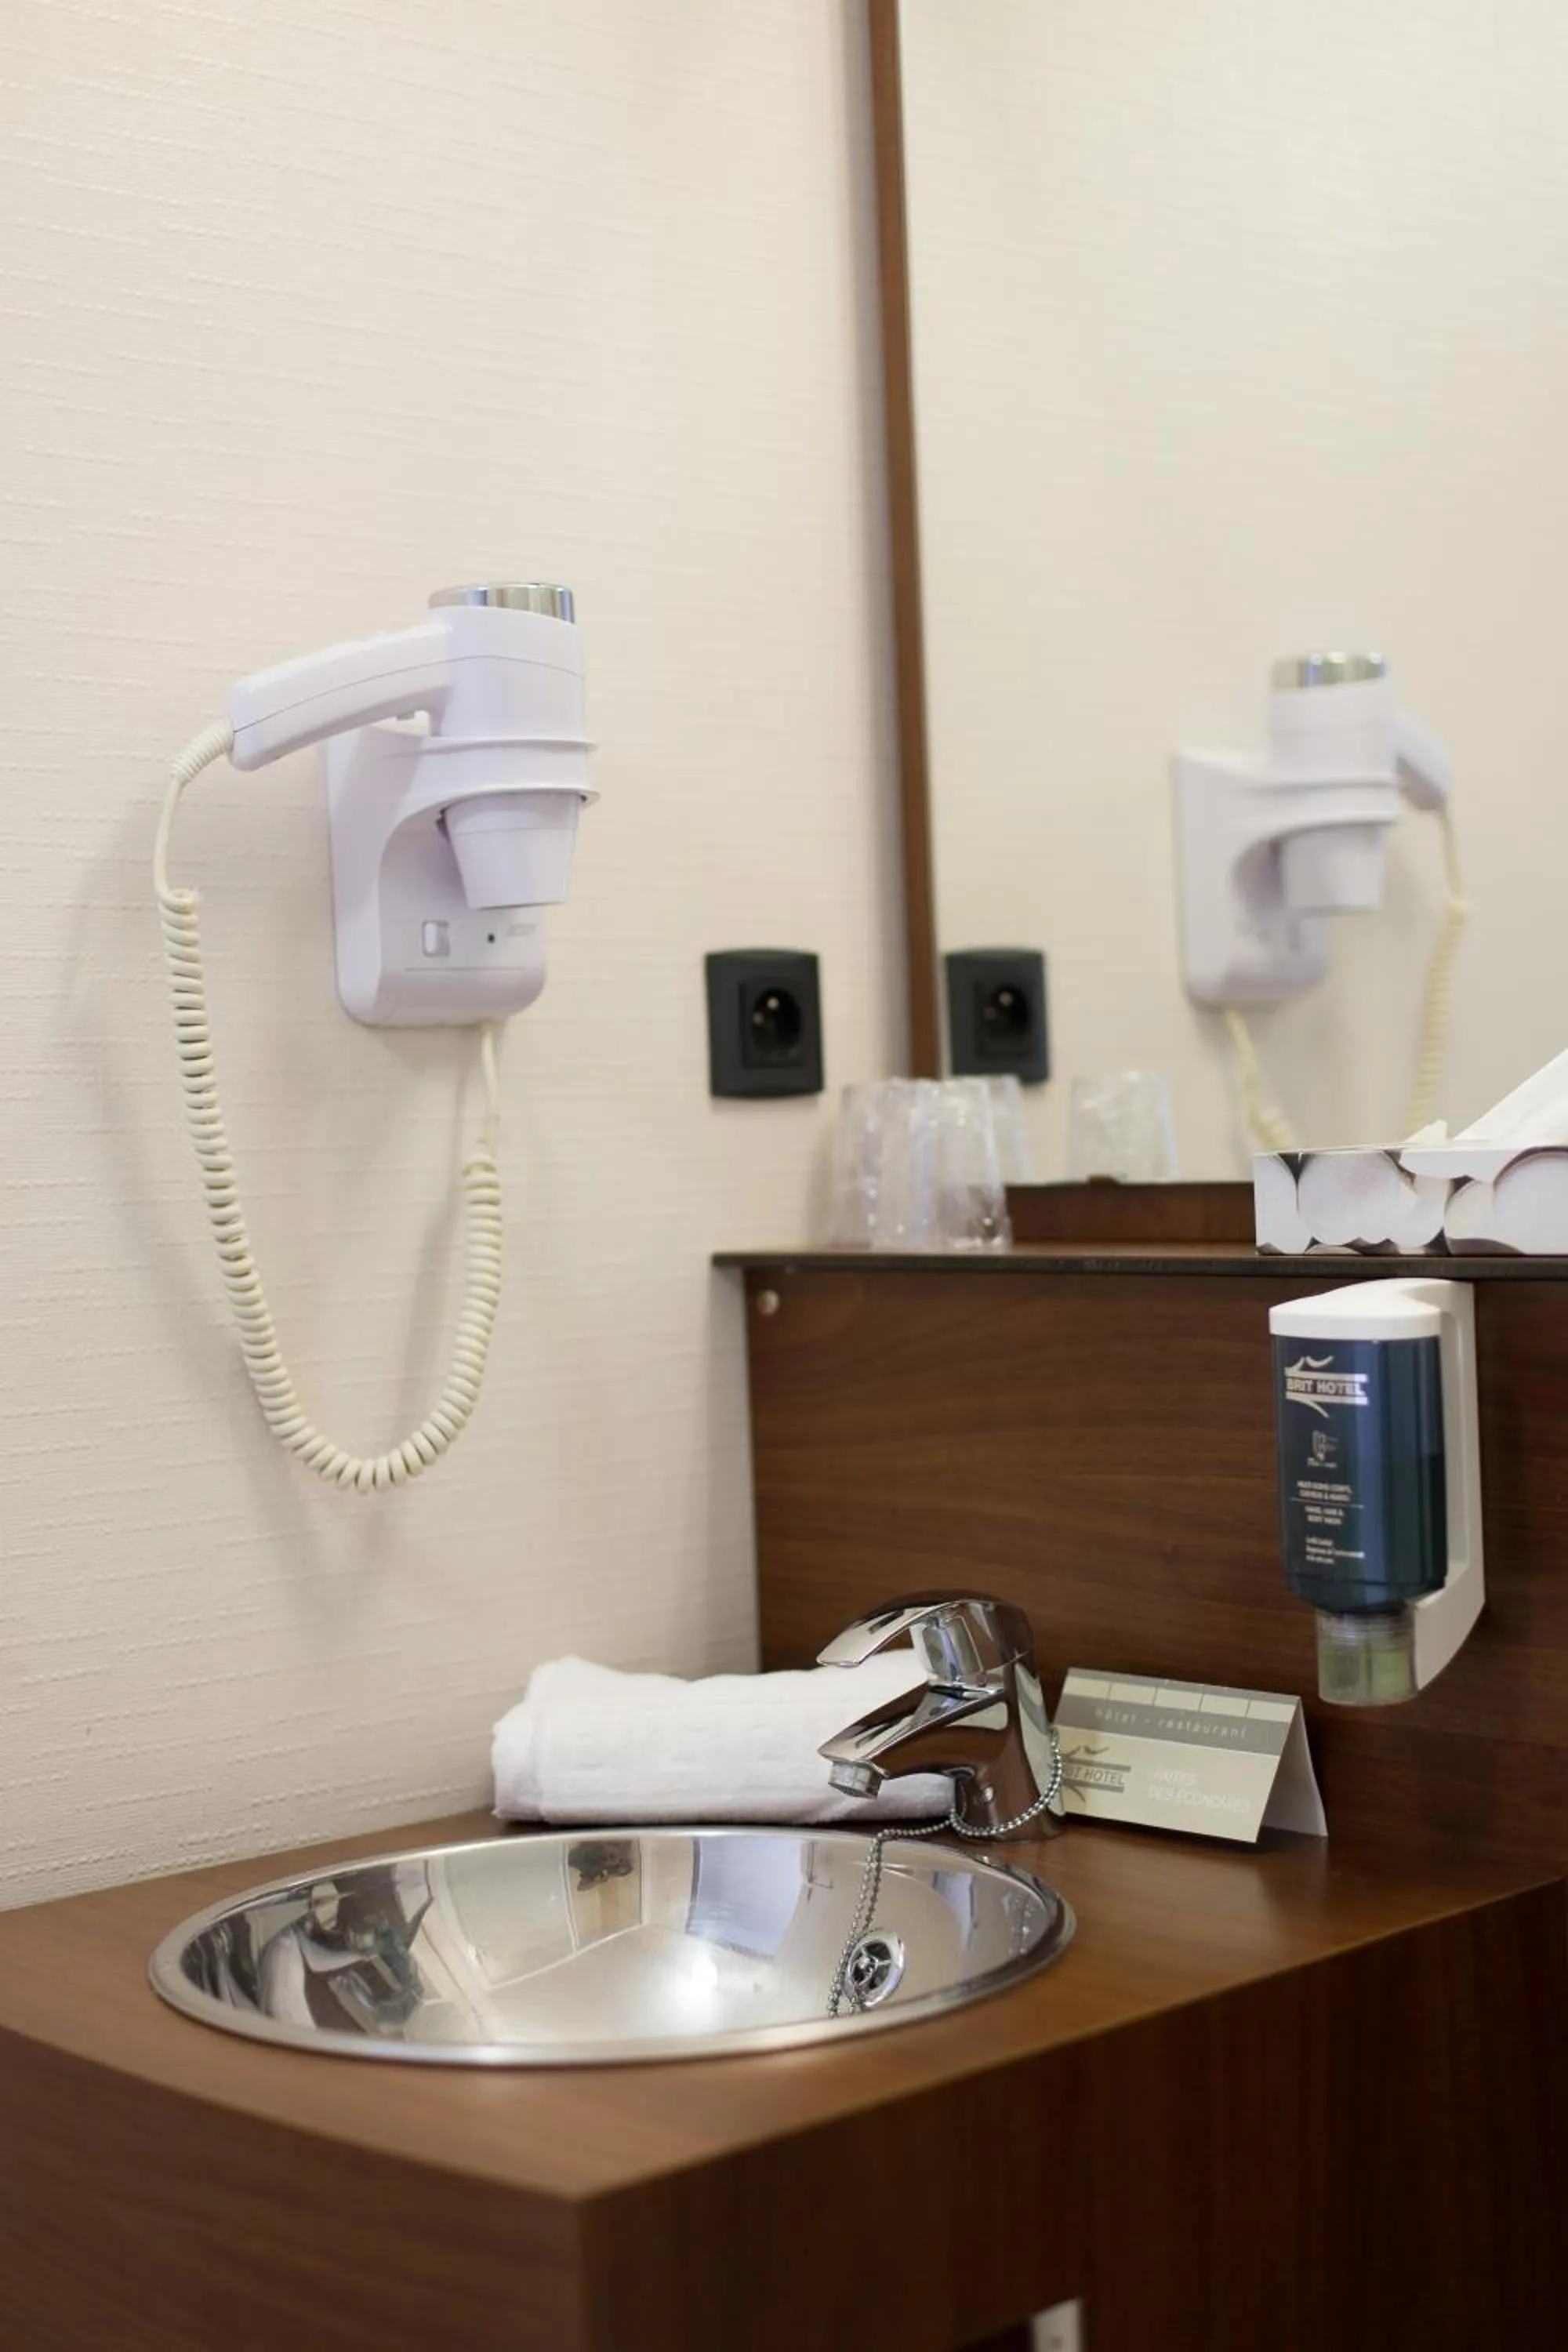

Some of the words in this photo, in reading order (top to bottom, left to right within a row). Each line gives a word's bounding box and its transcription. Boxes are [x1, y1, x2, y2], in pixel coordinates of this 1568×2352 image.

[1287, 1377, 1312, 1392] BRIT
[1316, 1380, 1366, 1396] HOTEL
[1083, 1768, 1125, 1785] HOTEL
